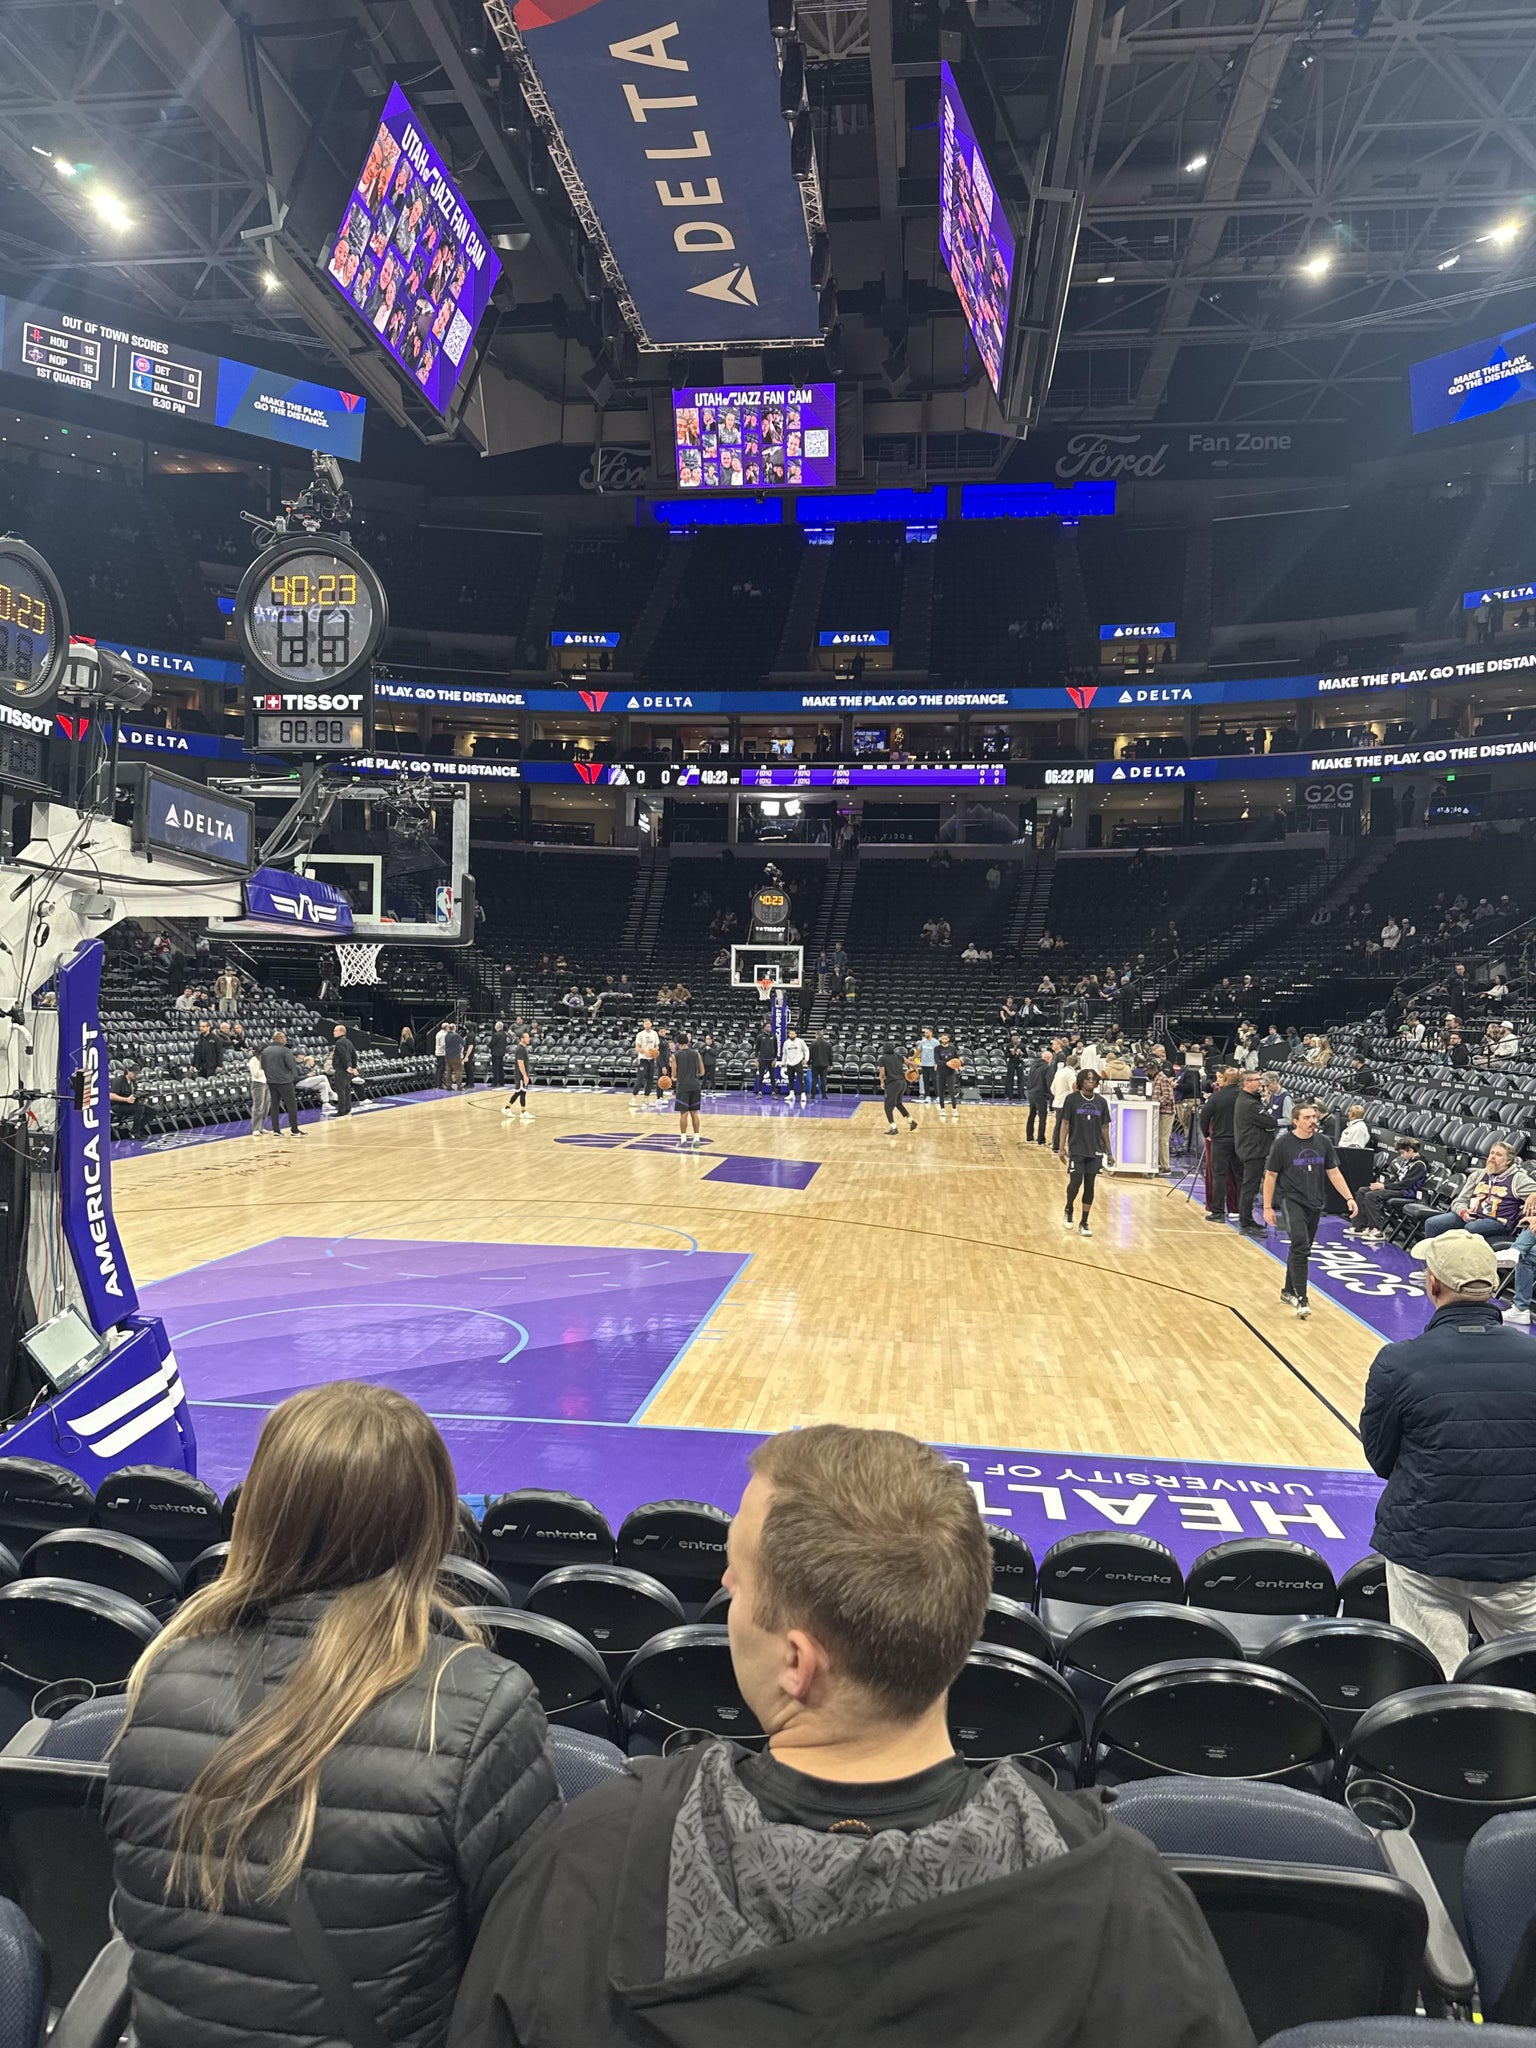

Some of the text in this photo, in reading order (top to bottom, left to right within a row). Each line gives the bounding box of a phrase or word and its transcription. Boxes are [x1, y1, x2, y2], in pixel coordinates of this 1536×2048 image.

[608, 21, 735, 252] DELTA
[401, 123, 487, 271] UTAH JAZZ FAN CAM
[62, 315, 169, 355] OUT OF TOWN SCORES
[49, 336, 95, 356] HOU 16
[48, 354, 94, 374] NOP 15
[1453, 355, 1527, 385] MAKE THE PLAY.
[36, 367, 92, 390] 1ST QUARTER
[155, 365, 195, 384] DET 0
[1448, 362, 1534, 395] GO THE DISTANCE.
[153, 382, 194, 401] DAL 0
[695, 389, 812, 407] UTAH JAZZ FAN CAM
[152, 397, 186, 415] 6:30 PM
[254, 401, 329, 428] GO THE DISTANCE.
[260, 394, 325, 419] MAKE THE PLAY.
[1189, 432, 1292, 452] Fan Zone
[1055, 433, 1169, 478] Ford
[271, 574, 357, 606] 40:23
[0, 583, 46, 635] 0:23
[575, 635, 606, 643] DELTA
[843, 634, 875, 643] DELTA
[1125, 626, 1160, 636] DELTA
[137, 652, 194, 673] DELTA
[1318, 676, 1359, 691] MAKE
[1361, 673, 1389, 686] THE
[1391, 669, 1428, 684] PLAY.
[1430, 666, 1454, 679] GO
[1456, 661, 1484, 676] THE
[282, 694, 363, 711] TISSOT
[381, 684, 414, 697] PLAY.
[415, 689, 435, 699] GO
[437, 690, 461, 702] THE
[462, 692, 525, 705] DISTANCE.
[643, 696, 693, 708] DELTA
[802, 694, 1008, 707] MAKE THE PLAY. GO THE DISTANCE.
[1137, 688, 1193, 701] DELTA
[131, 731, 188, 750] DELTA
[1311, 740, 1536, 771] MAKE THE PLAY. GO THE DISTAN
[375, 757, 408, 771] PLAY.
[410, 761, 430, 772] GO
[432, 762, 456, 774] THE
[458, 764, 520, 777] DISTANCE.
[1044, 768, 1094, 784] 06:22 PM
[1130, 765, 1186, 778] DELTA
[636, 770, 646, 784] 0
[661, 770, 670, 784] 0
[701, 770, 728, 785] 40:23
[1304, 782, 1353, 803] G2G
[184, 809, 234, 842] DELTA
[759, 895, 784, 905] 40:23
[84, 1134, 123, 1297] AMERICA
[984, 1463, 1042, 1479] OF
[1056, 1467, 1315, 1497] UNIVERSITY
[149, 1503, 208, 1515] entrata
[967, 1479, 1346, 1539] HEALT
[535, 1529, 597, 1541] entrata
[678, 1538, 728, 1552] entrat
[1104, 1571, 1172, 1584] entrata
[1255, 1579, 1324, 1590] entrata
